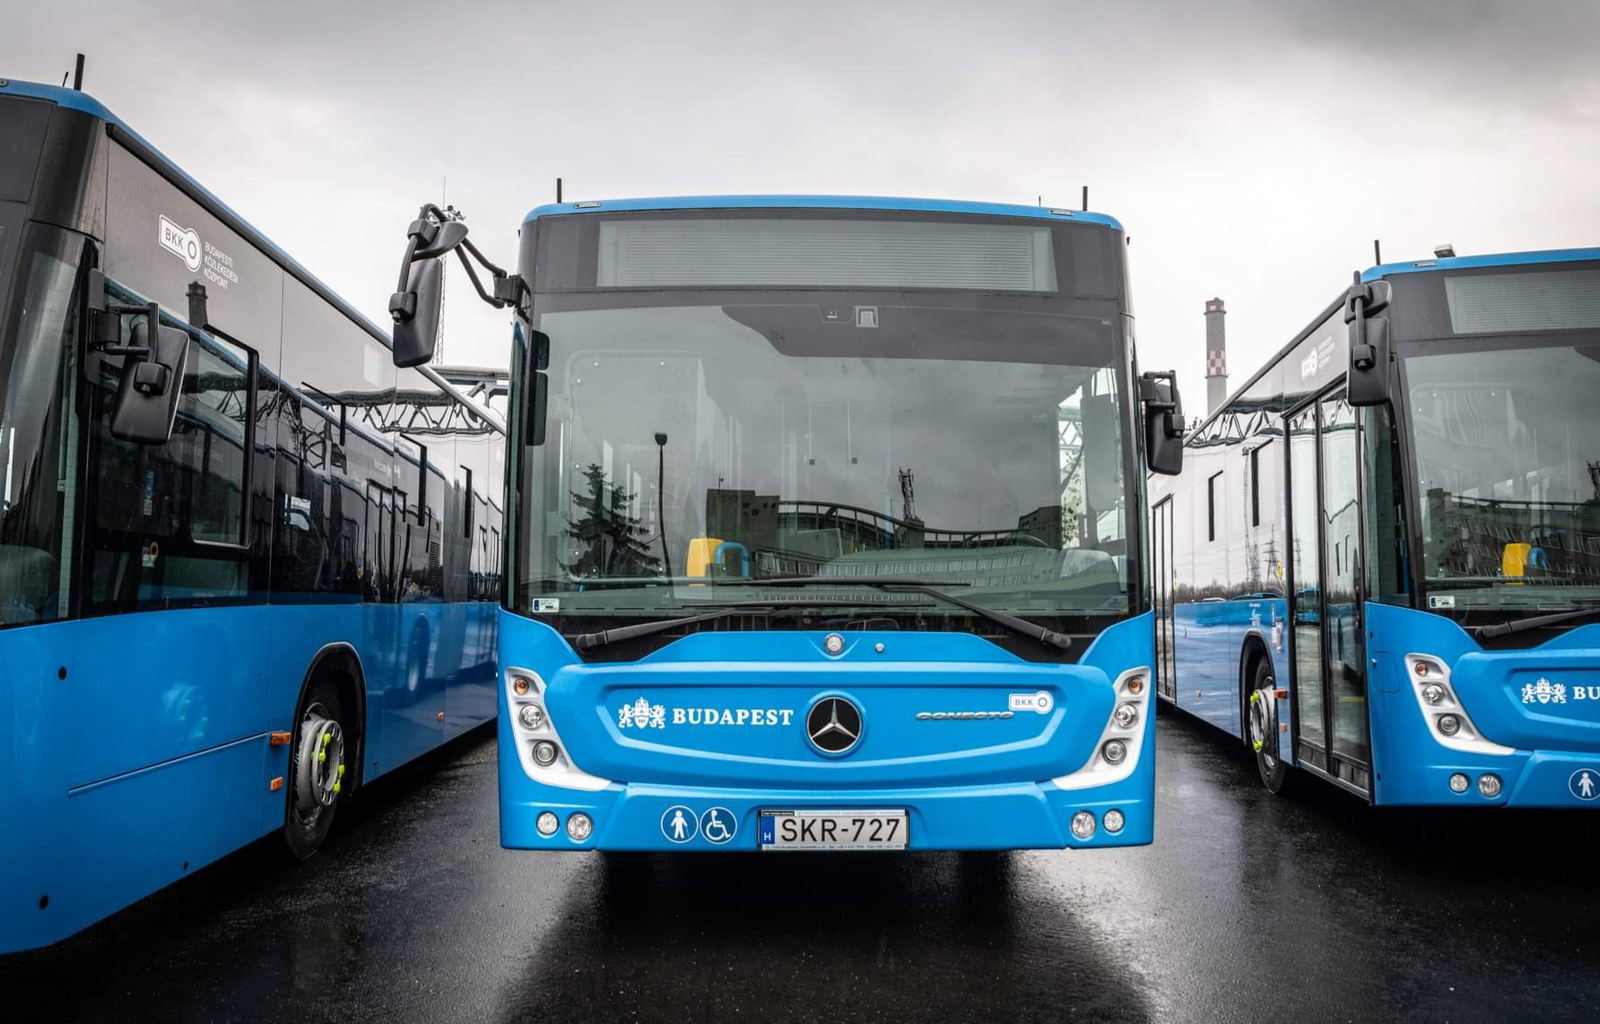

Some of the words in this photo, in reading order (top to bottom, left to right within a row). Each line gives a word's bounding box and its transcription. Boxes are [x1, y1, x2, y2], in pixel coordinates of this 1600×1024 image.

[165, 228, 184, 250] BKK
[1015, 698, 1034, 706] BKK
[672, 707, 795, 726] BUDAPEST
[915, 711, 1015, 721] CONECTO
[763, 832, 772, 841] H
[781, 818, 900, 842] SKR-727
